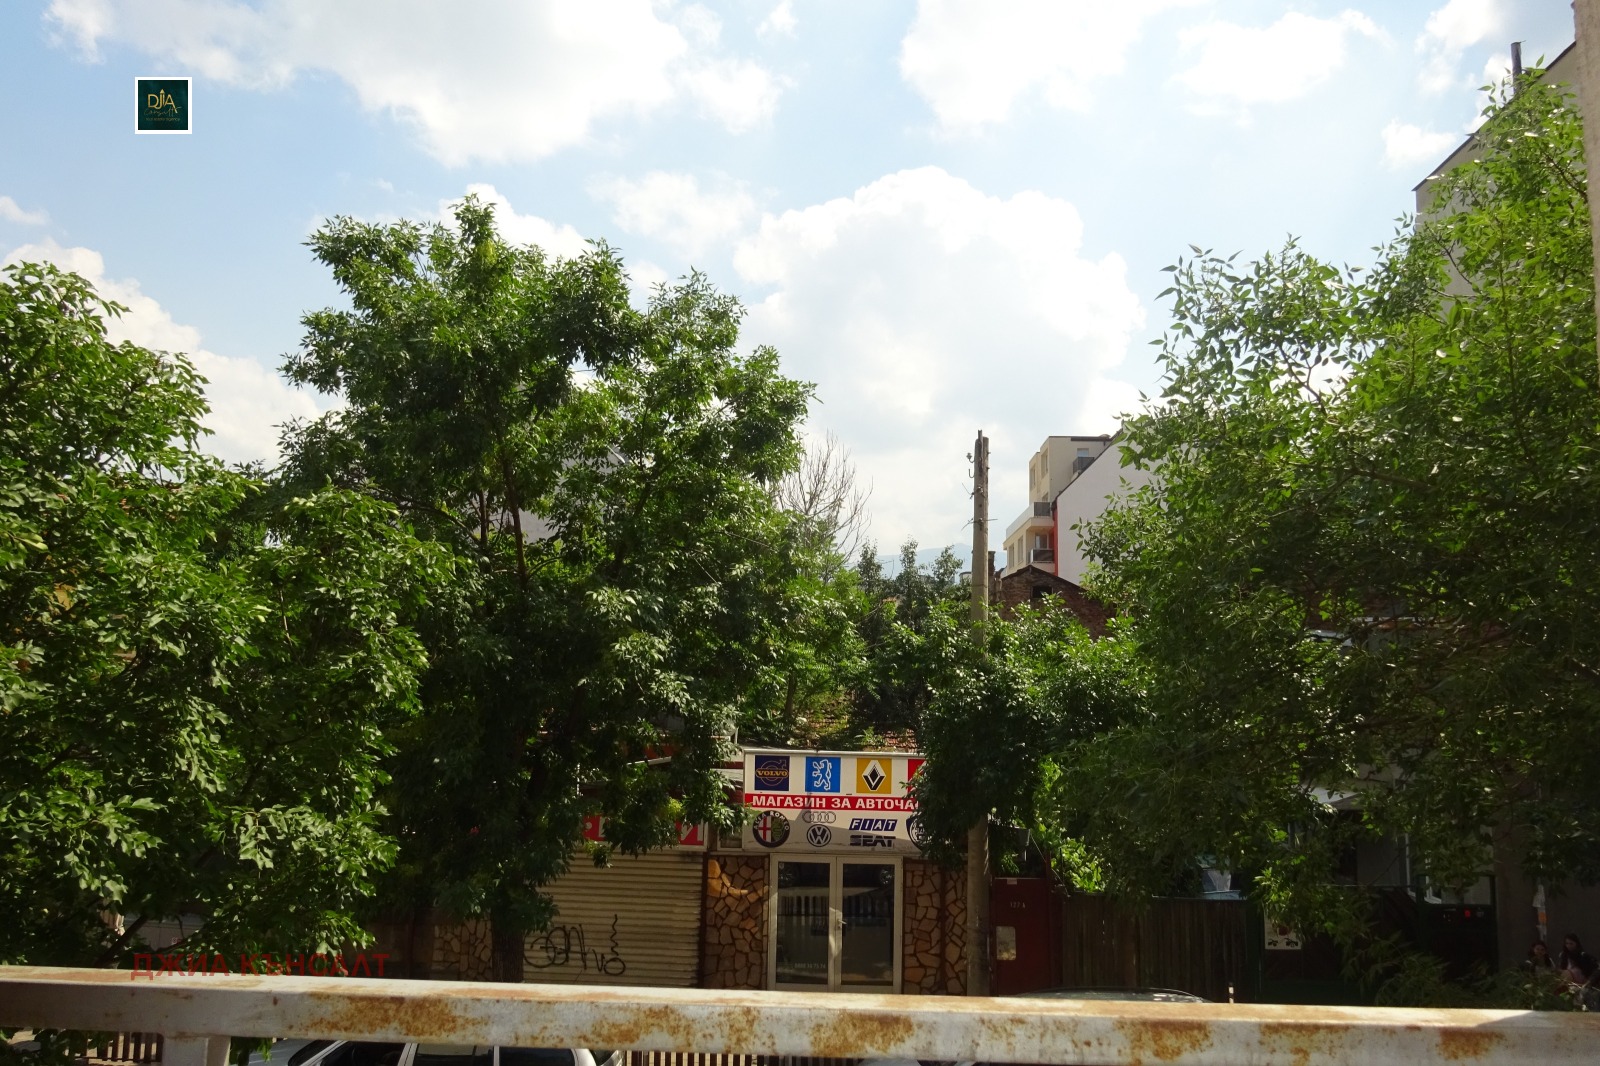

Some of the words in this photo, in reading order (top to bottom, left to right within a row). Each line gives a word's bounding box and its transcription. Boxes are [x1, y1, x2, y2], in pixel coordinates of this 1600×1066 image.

[752, 795, 826, 808] МАГАЗИН
[831, 798, 851, 809] ЗА
[850, 819, 897, 831] FIAT
[850, 835, 896, 847] SEAT
